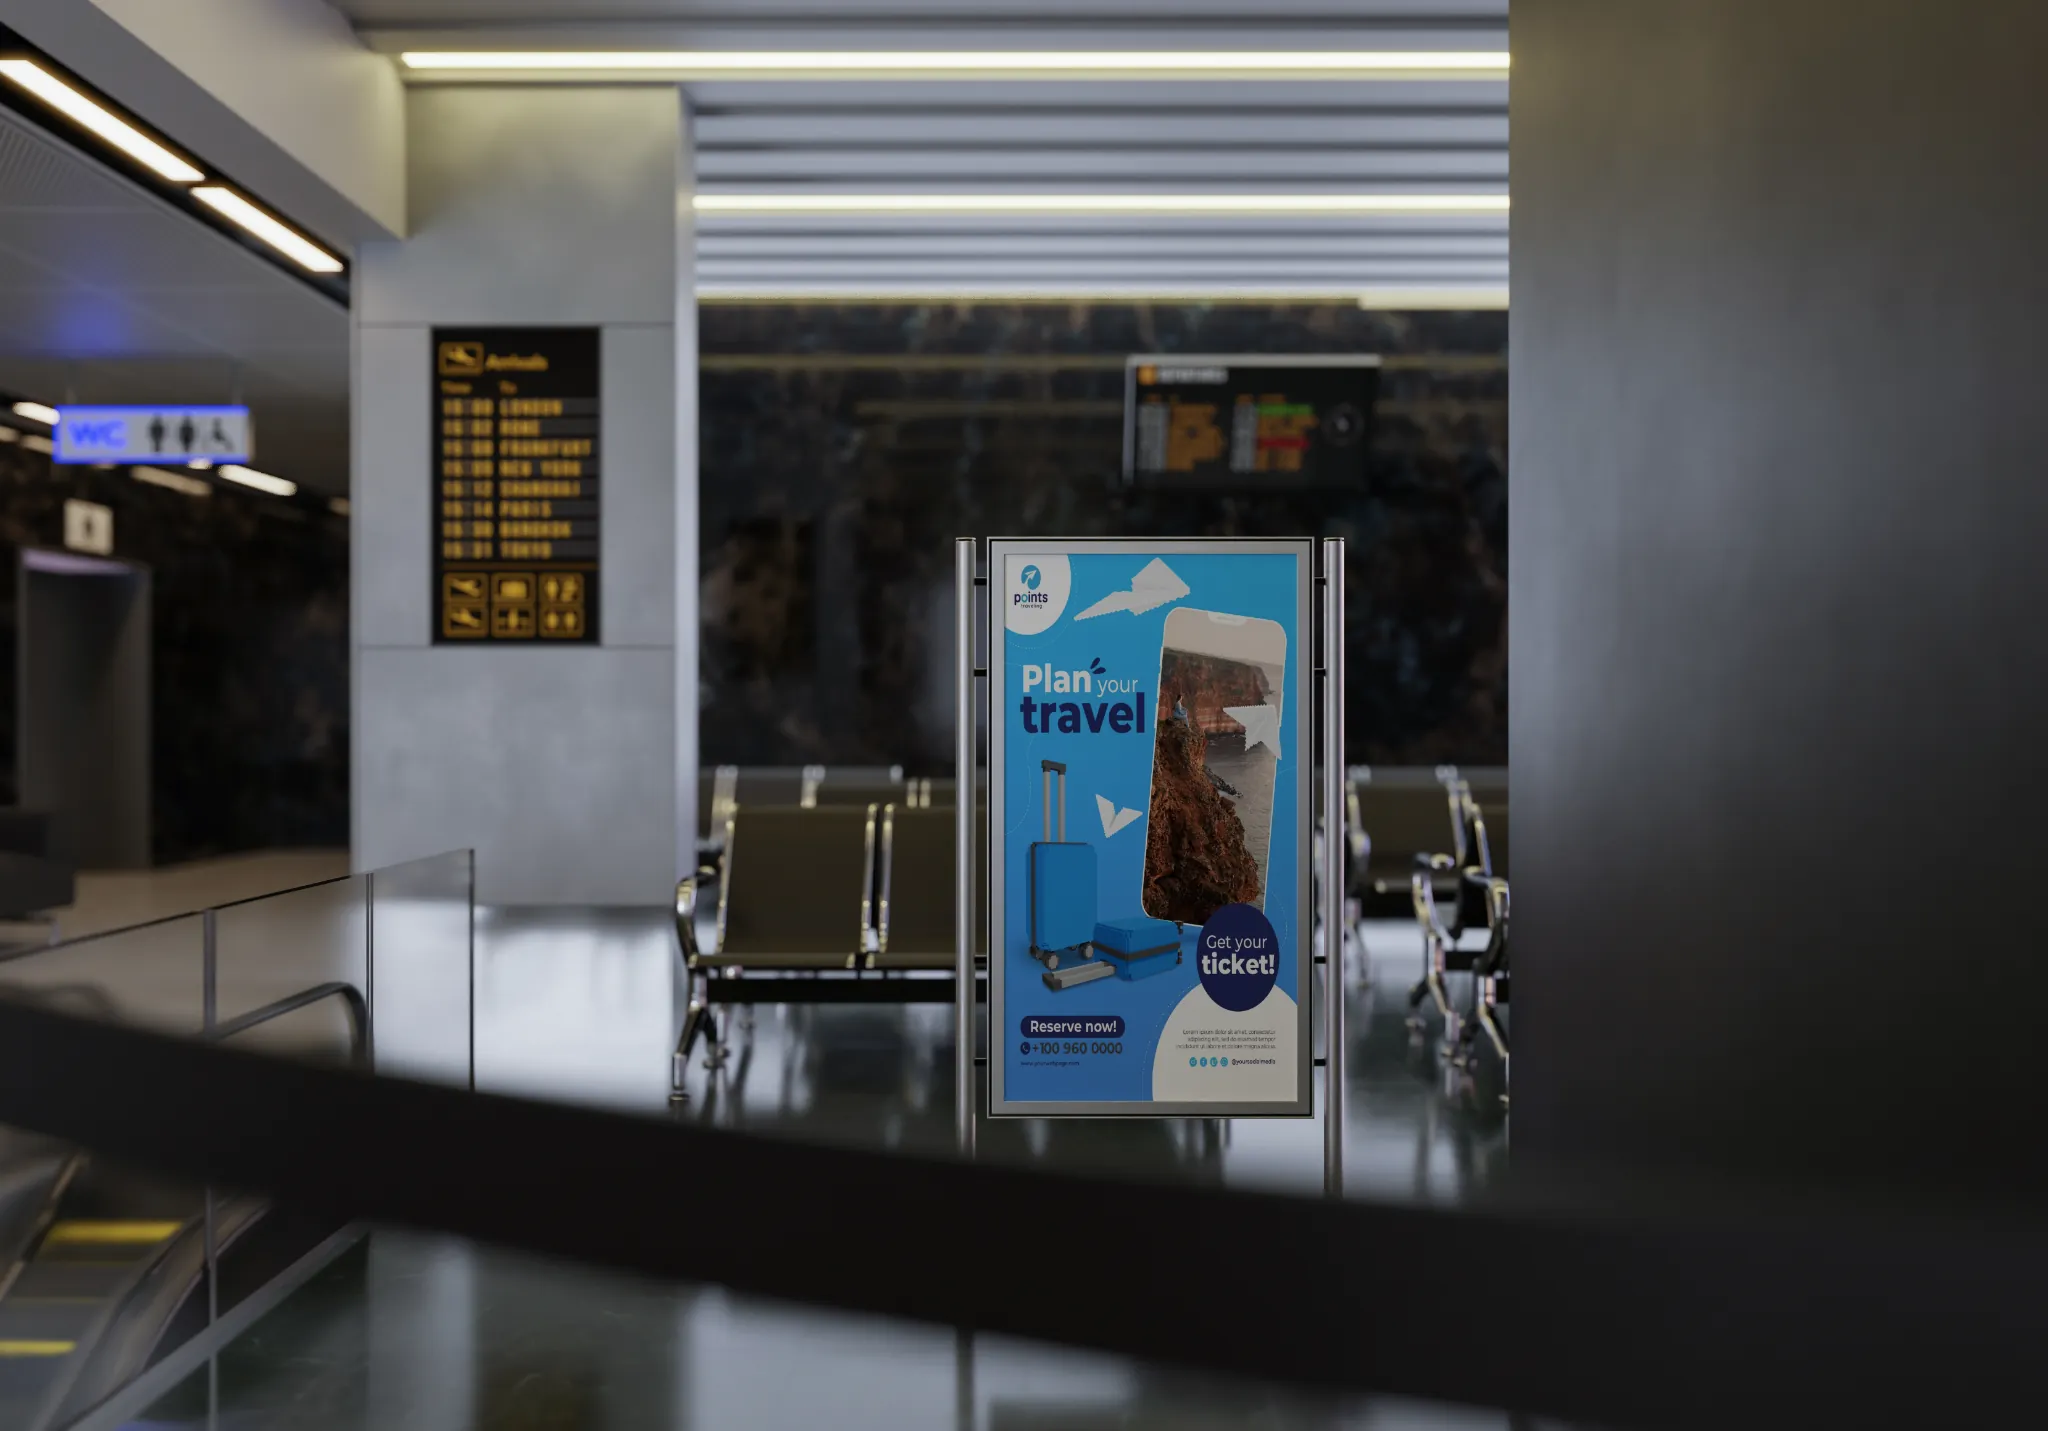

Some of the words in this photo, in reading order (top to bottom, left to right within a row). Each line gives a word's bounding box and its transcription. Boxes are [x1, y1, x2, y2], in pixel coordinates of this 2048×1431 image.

[68, 420, 127, 448] WC
[1014, 591, 1048, 605] points
[1023, 663, 1091, 693] Plan
[1097, 679, 1138, 697] your
[1020, 692, 1145, 734] travel
[1206, 935, 1231, 949] Get
[1235, 938, 1267, 952] your
[1202, 951, 1275, 975] ticket!
[1030, 1020, 1082, 1033] Reserve
[1086, 1020, 1117, 1033] now!
[1032, 1042, 1060, 1054] +100
[1063, 1042, 1087, 1054] 960
[1091, 1042, 1123, 1054] 0000
